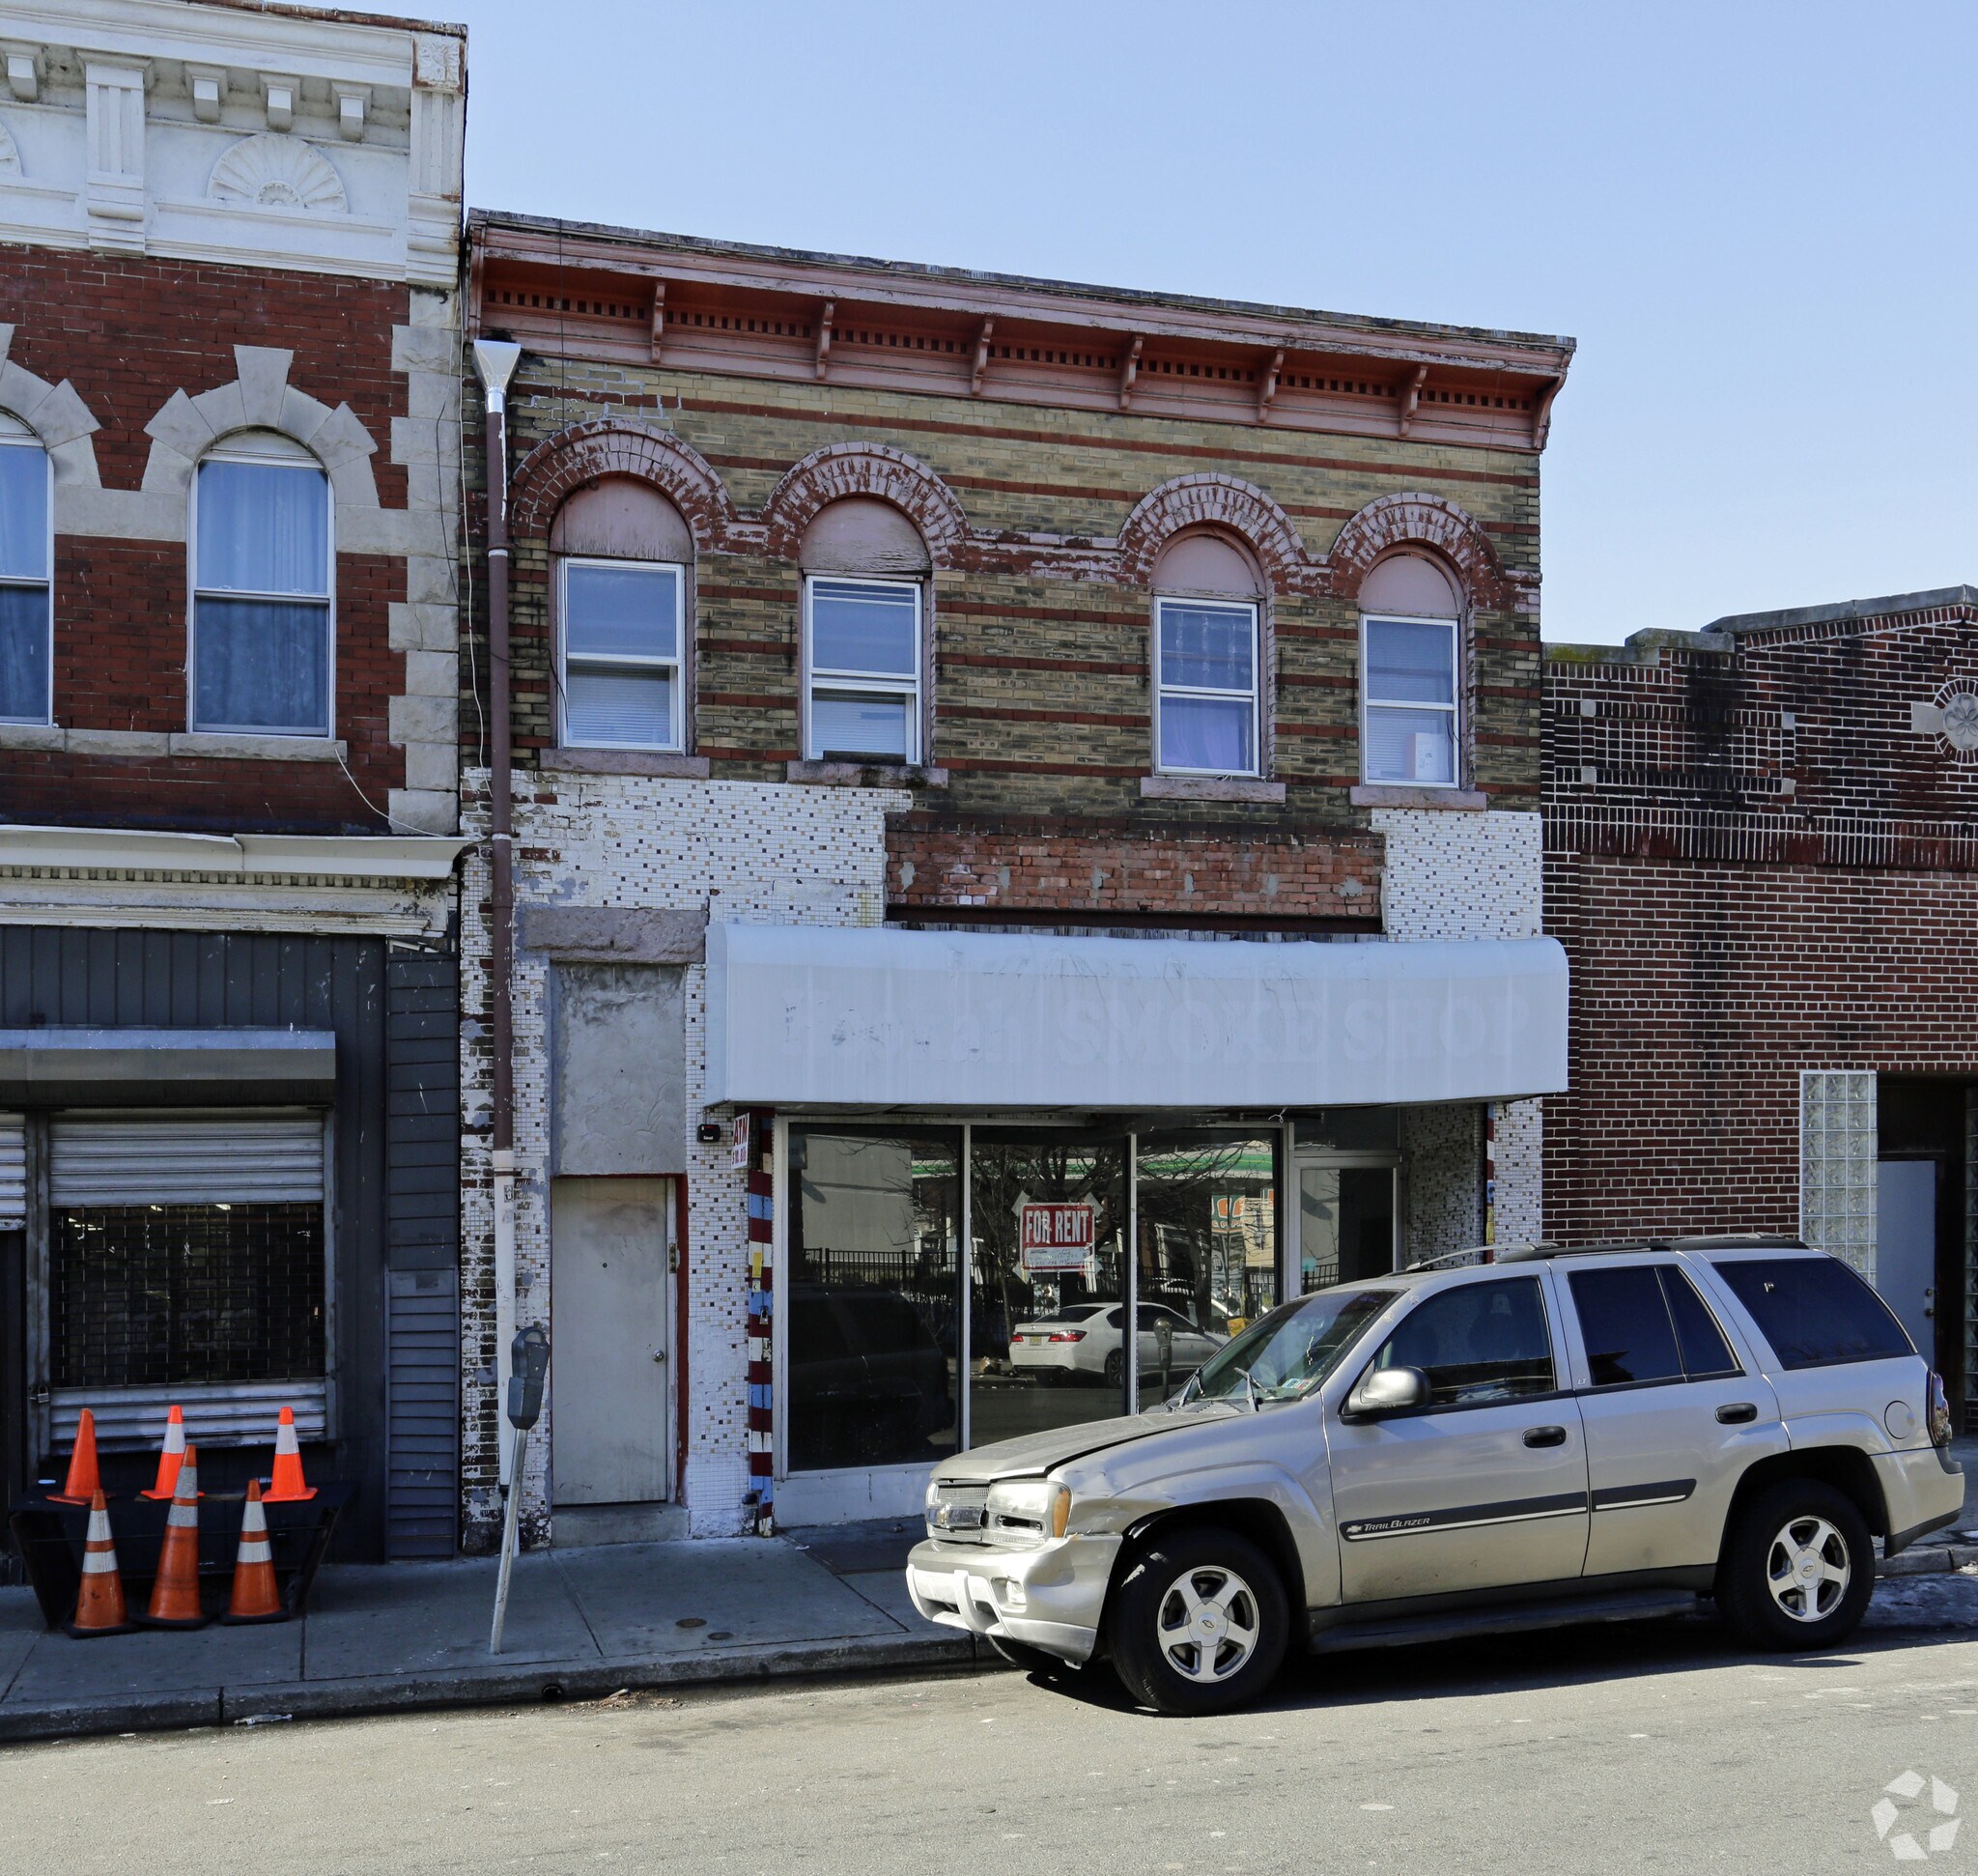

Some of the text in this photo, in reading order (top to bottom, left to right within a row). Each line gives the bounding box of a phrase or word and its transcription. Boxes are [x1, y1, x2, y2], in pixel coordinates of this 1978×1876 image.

[1058, 998, 1328, 1066] SMOKE
[1343, 996, 1530, 1062] SHOP
[734, 1116, 749, 1146] ATM
[1026, 1210, 1089, 1244] FOR RENT
[1363, 1517, 1430, 1532] TRAILBLAZER
